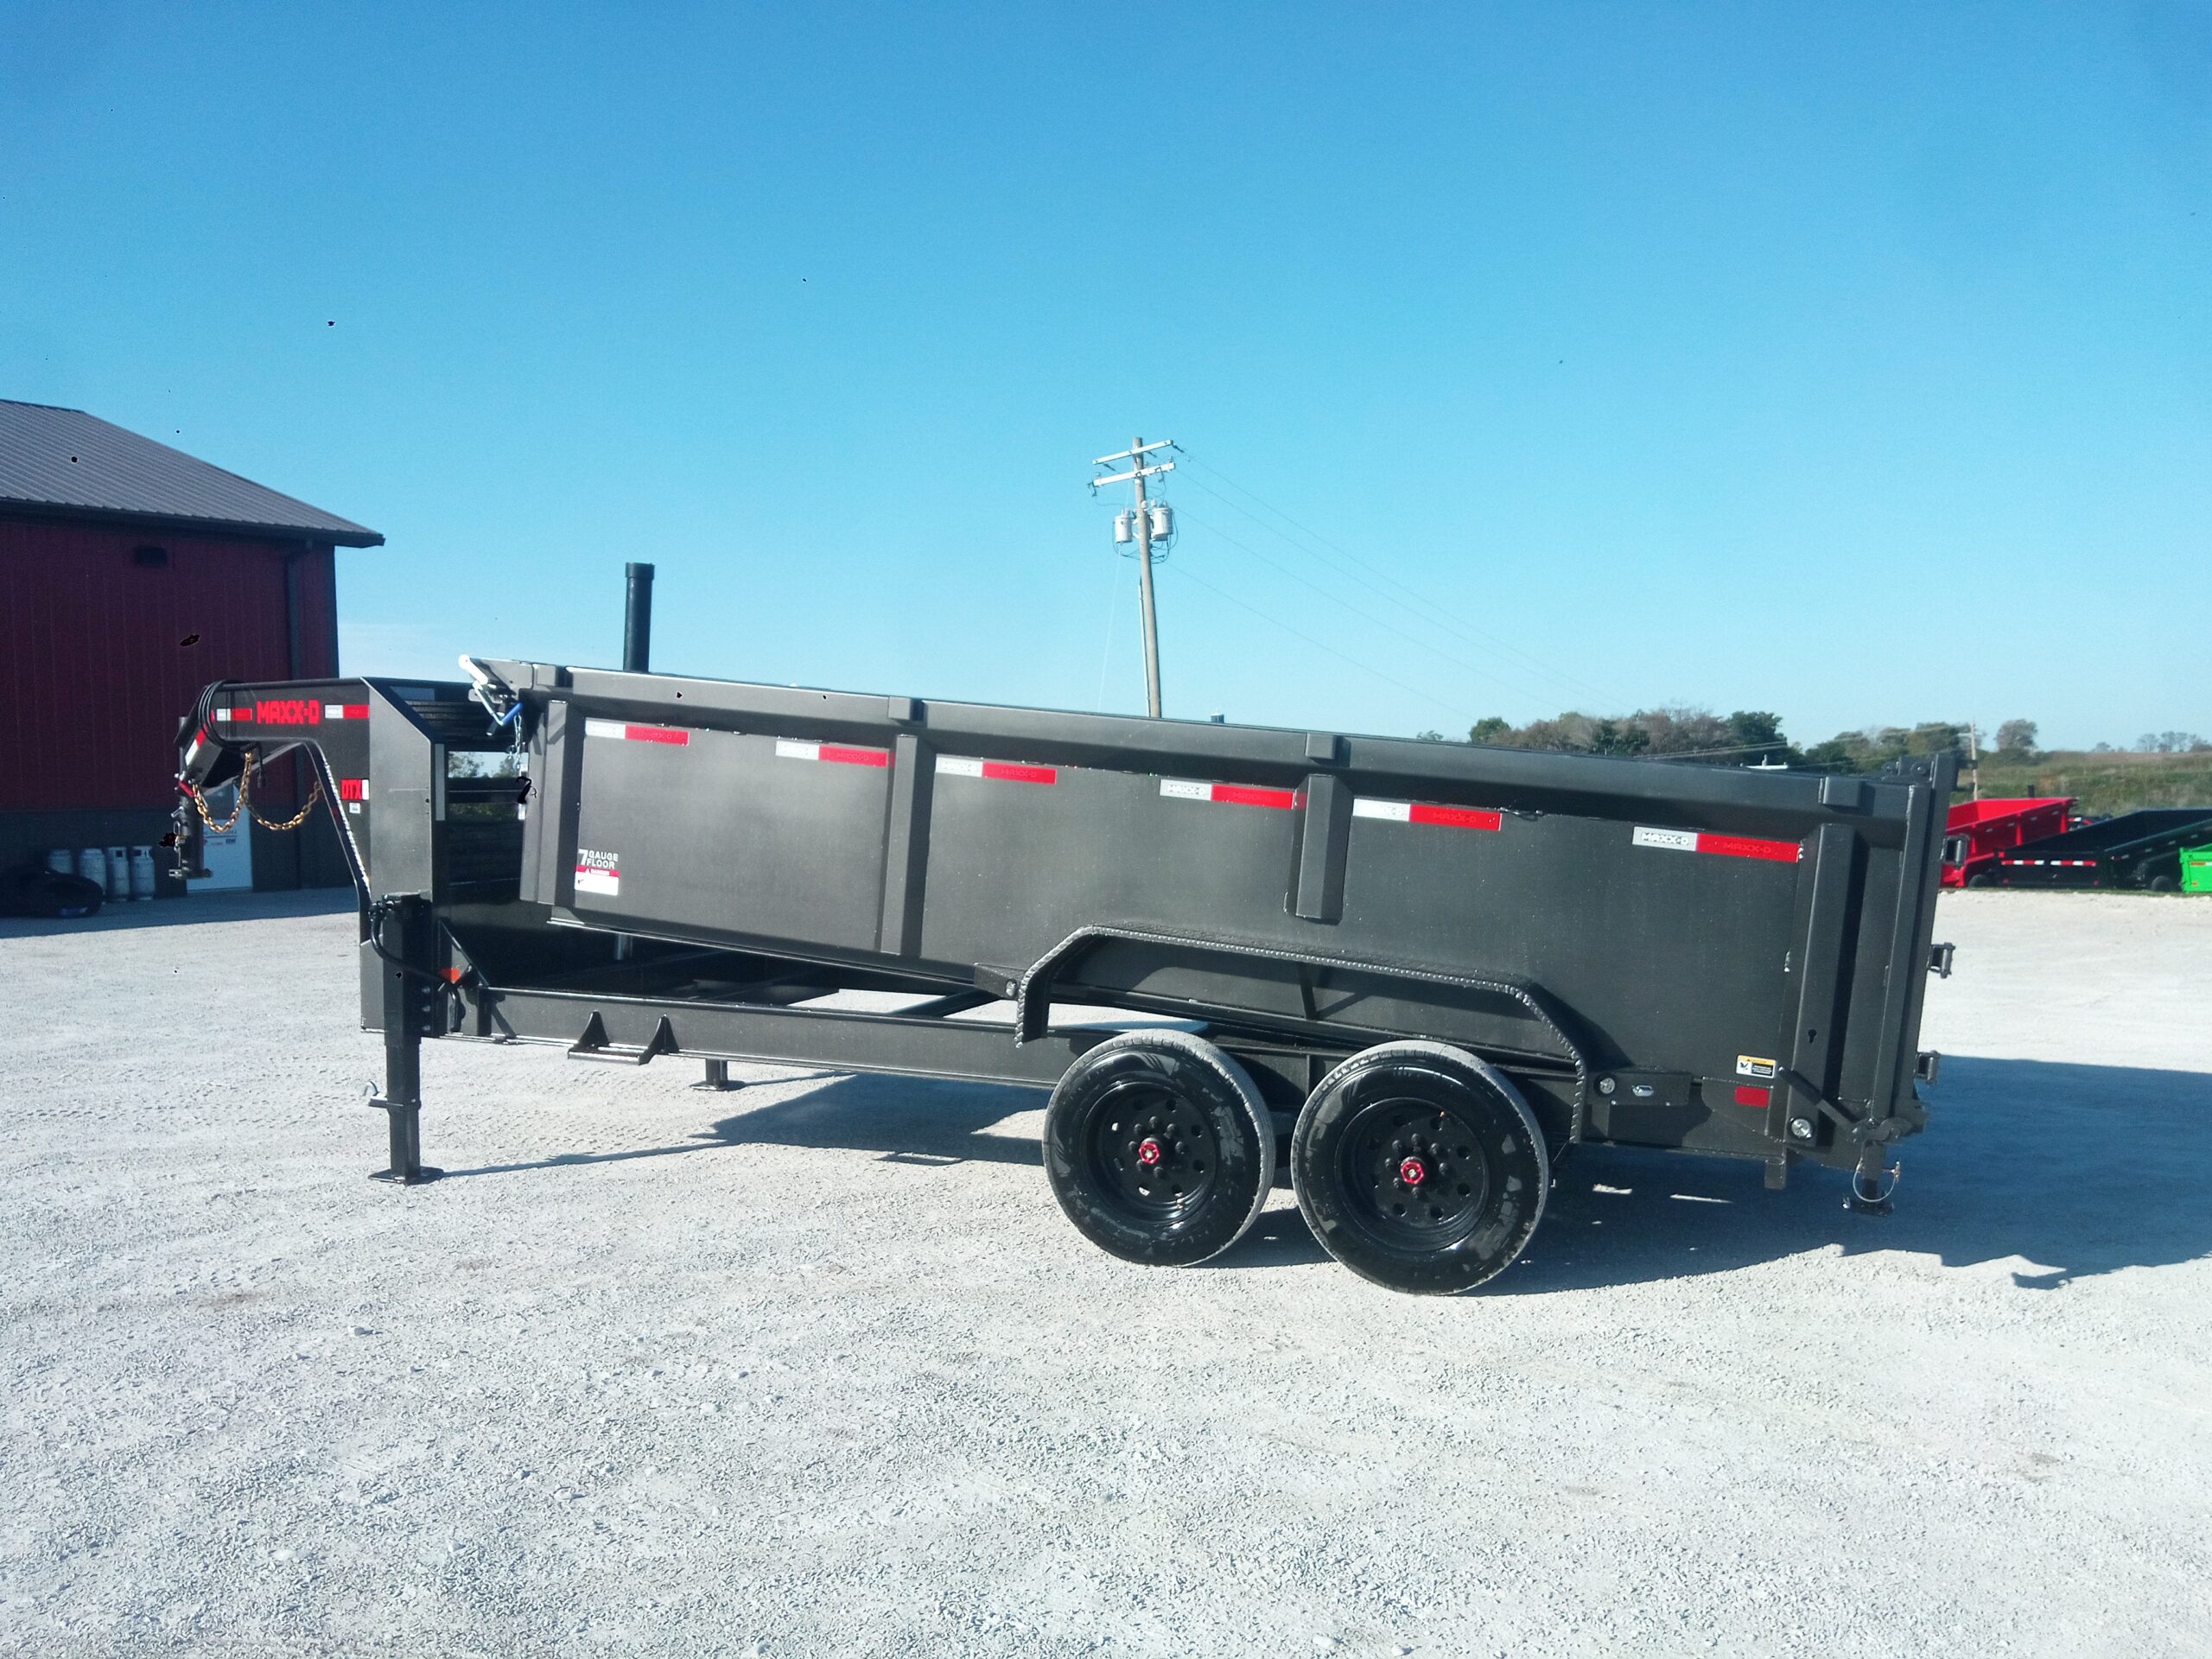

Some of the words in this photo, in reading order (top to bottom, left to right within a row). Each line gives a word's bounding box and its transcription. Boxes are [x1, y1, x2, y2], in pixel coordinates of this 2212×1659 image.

[257, 700, 320, 724] MAXX-D
[1641, 832, 1689, 846] MAXX-D
[1723, 842, 1771, 854] MAXX-D
[578, 849, 588, 866] 7
[588, 850, 619, 862] GAUGE
[586, 858, 615, 869] FLOOR
